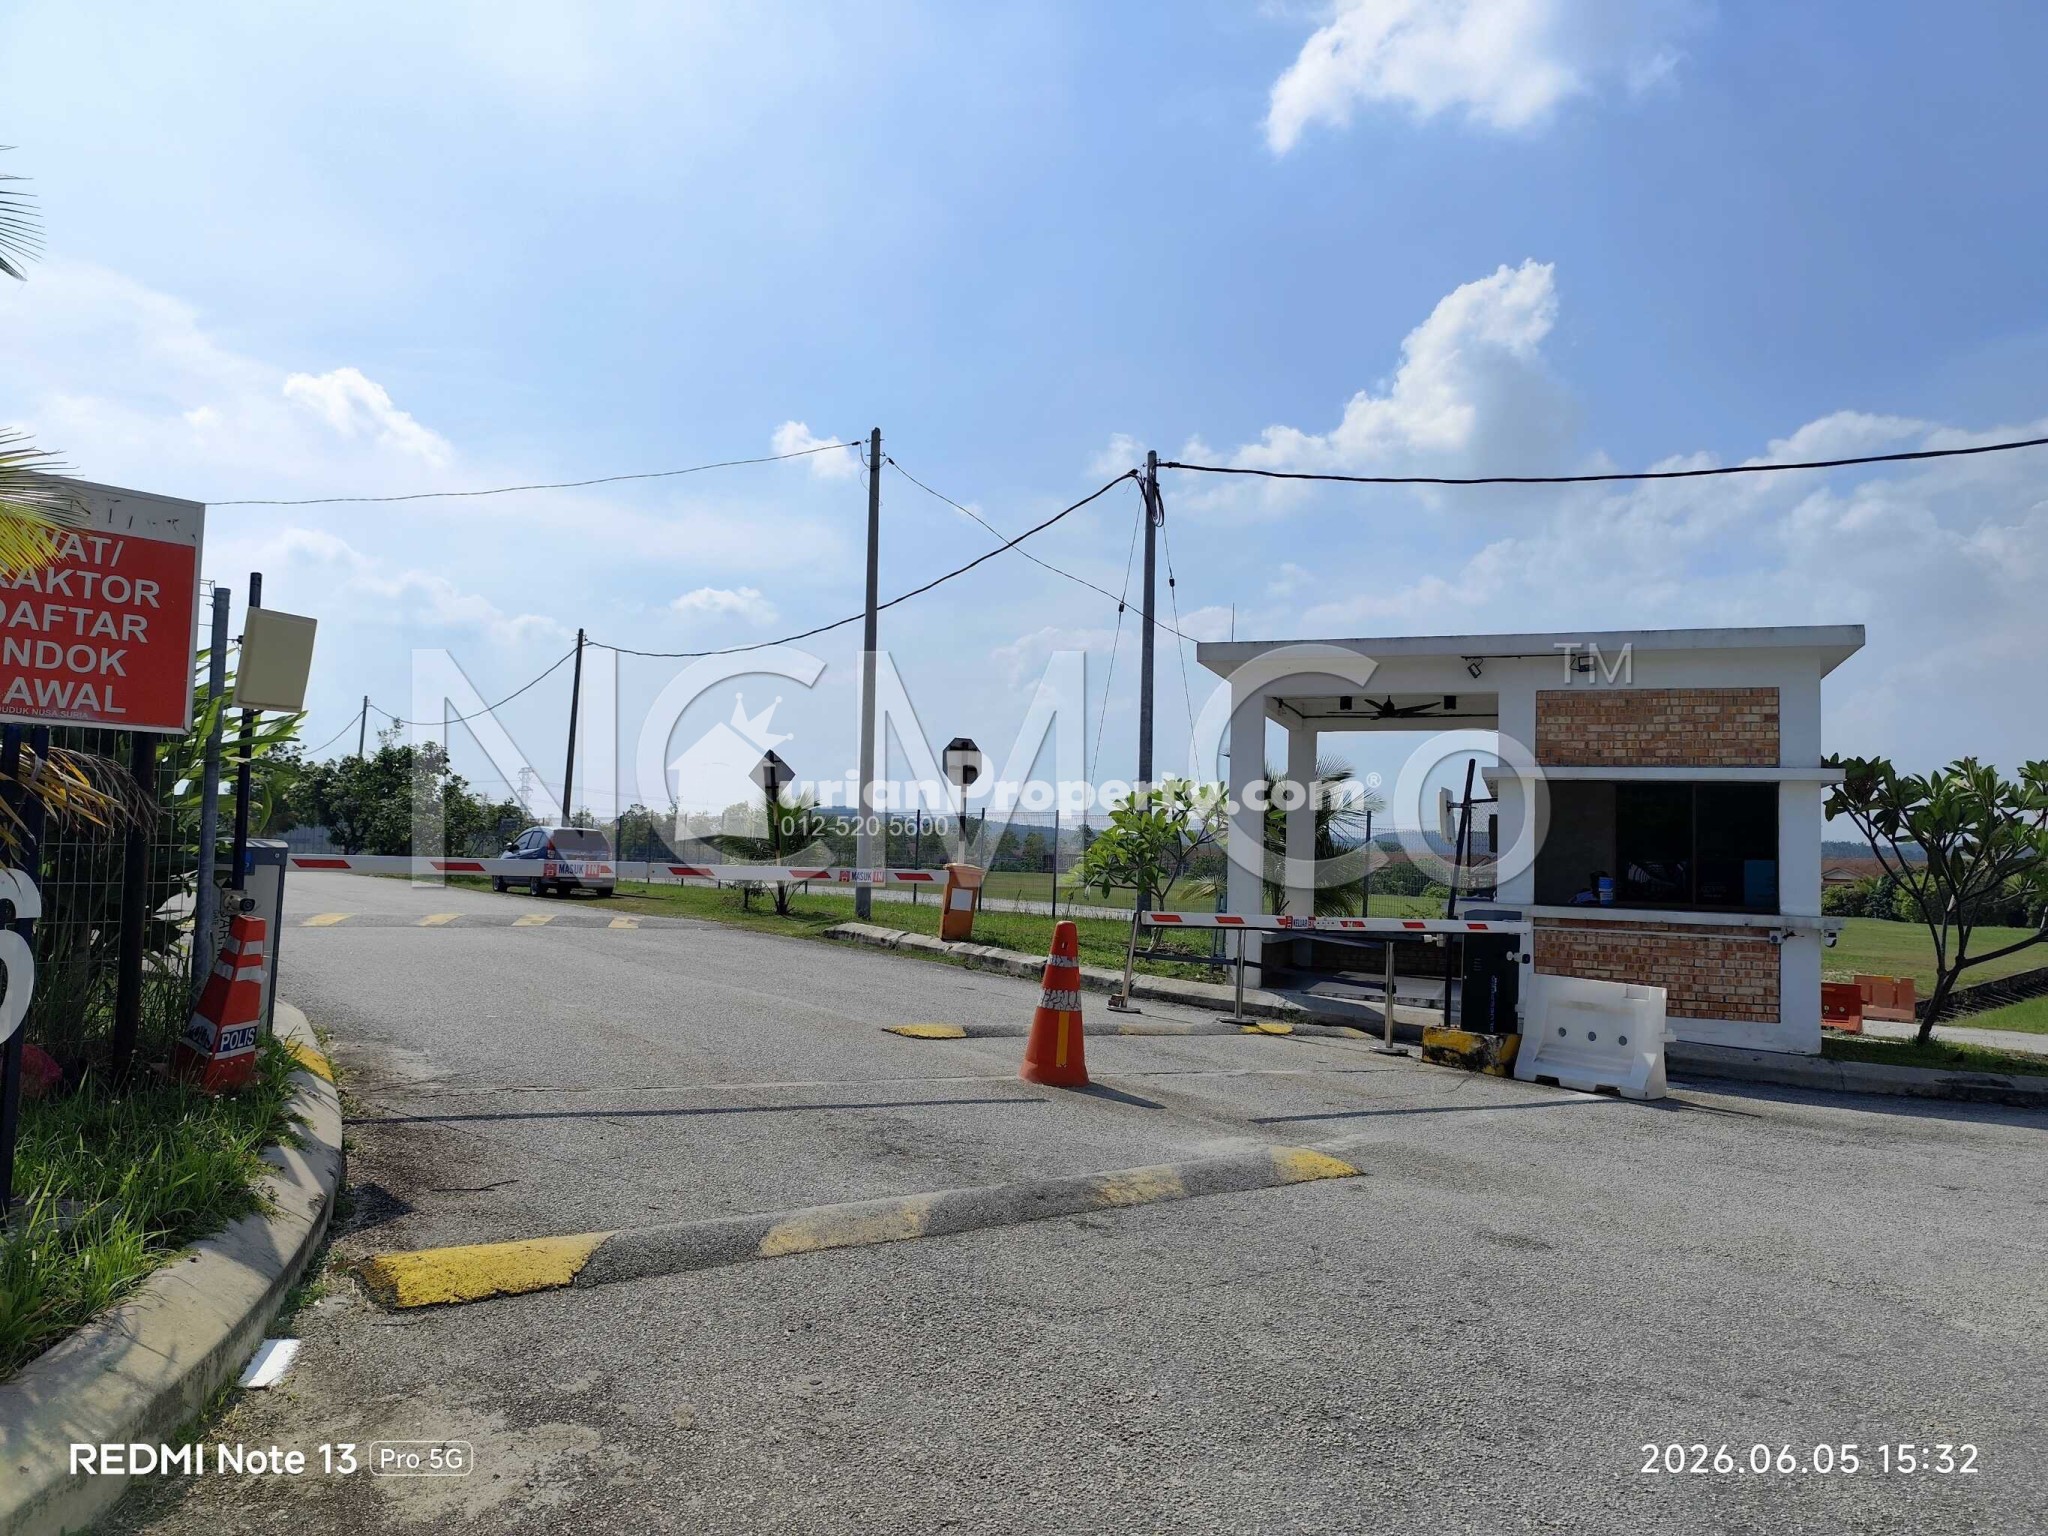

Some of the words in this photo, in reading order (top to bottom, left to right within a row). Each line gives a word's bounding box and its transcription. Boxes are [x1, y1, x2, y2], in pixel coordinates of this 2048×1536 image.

[0, 601, 149, 643] AFTAR
[3, 676, 126, 714] AWAL
[0, 707, 29, 715] UDUK
[31, 708, 58, 718] NUSA
[60, 711, 88, 720] SURIA
[558, 863, 584, 875] MASUK
[220, 1028, 256, 1051] POLIS
